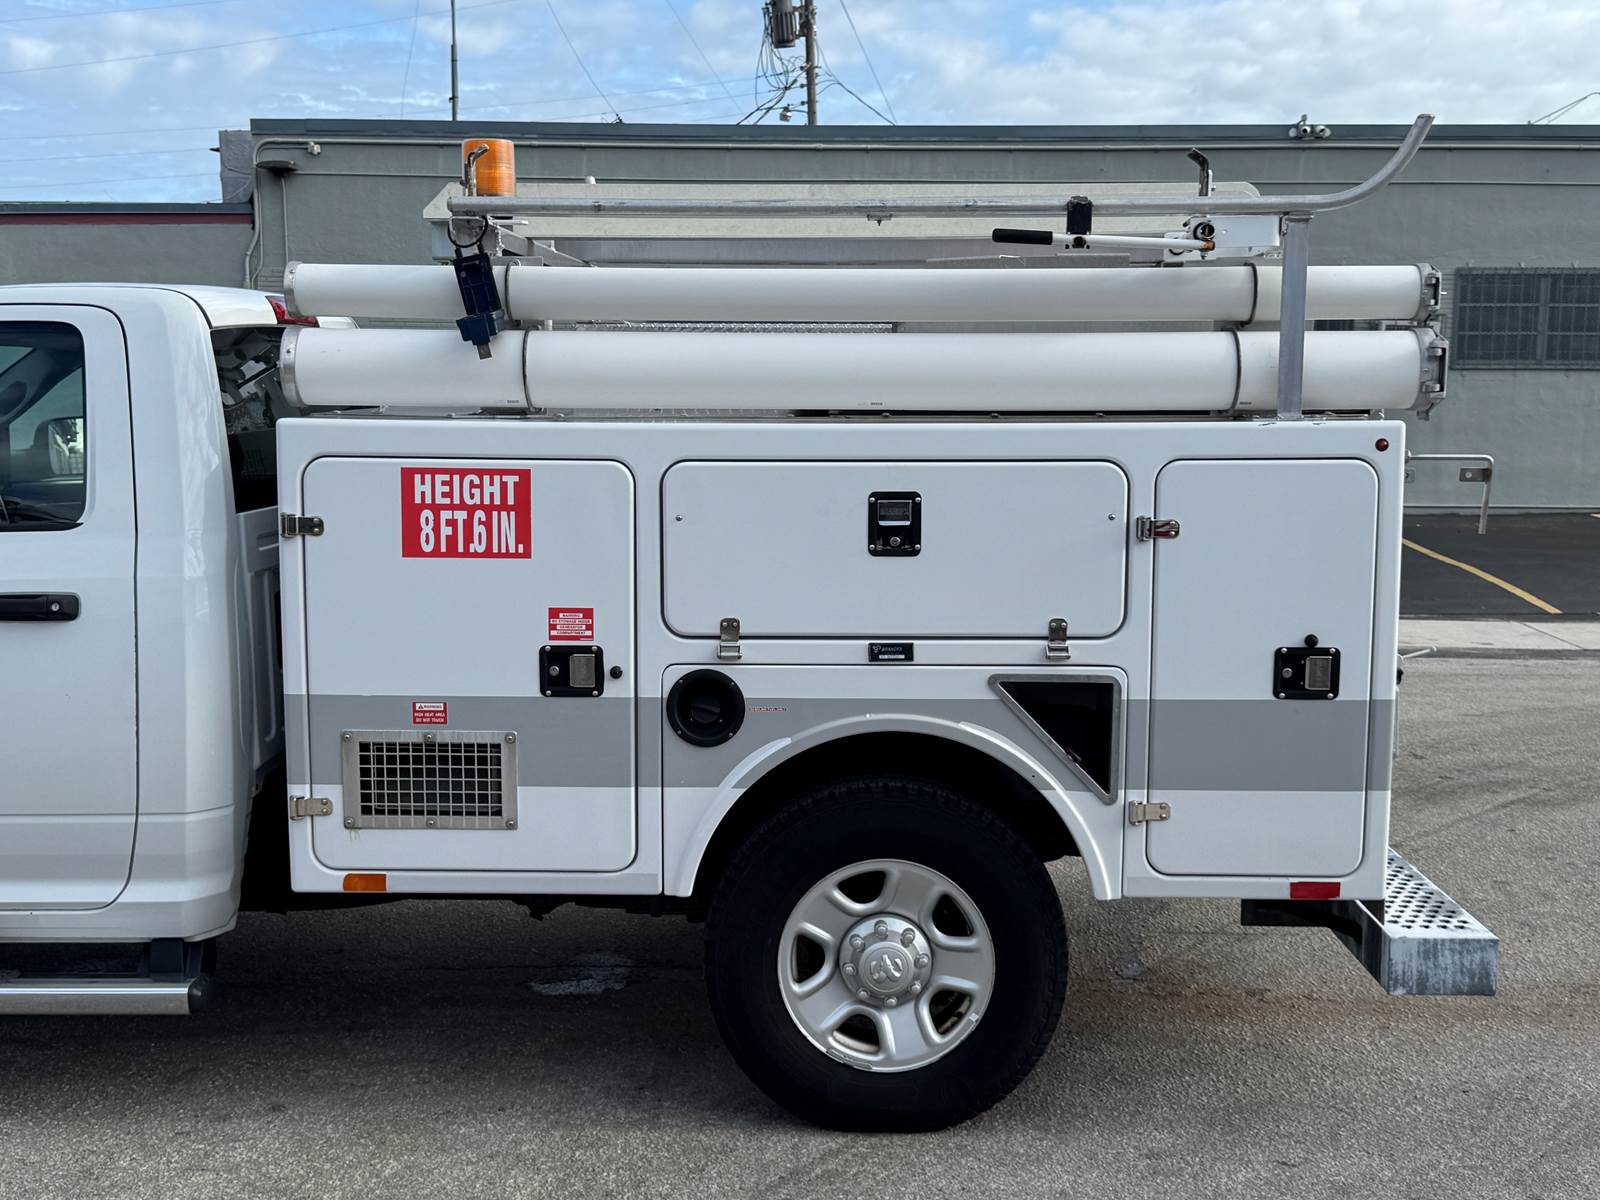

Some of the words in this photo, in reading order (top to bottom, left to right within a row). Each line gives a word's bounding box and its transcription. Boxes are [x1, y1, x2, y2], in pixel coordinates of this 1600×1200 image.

[414, 474, 520, 506] HEIGHT
[420, 509, 435, 553] 8
[492, 511, 524, 554] IN.
